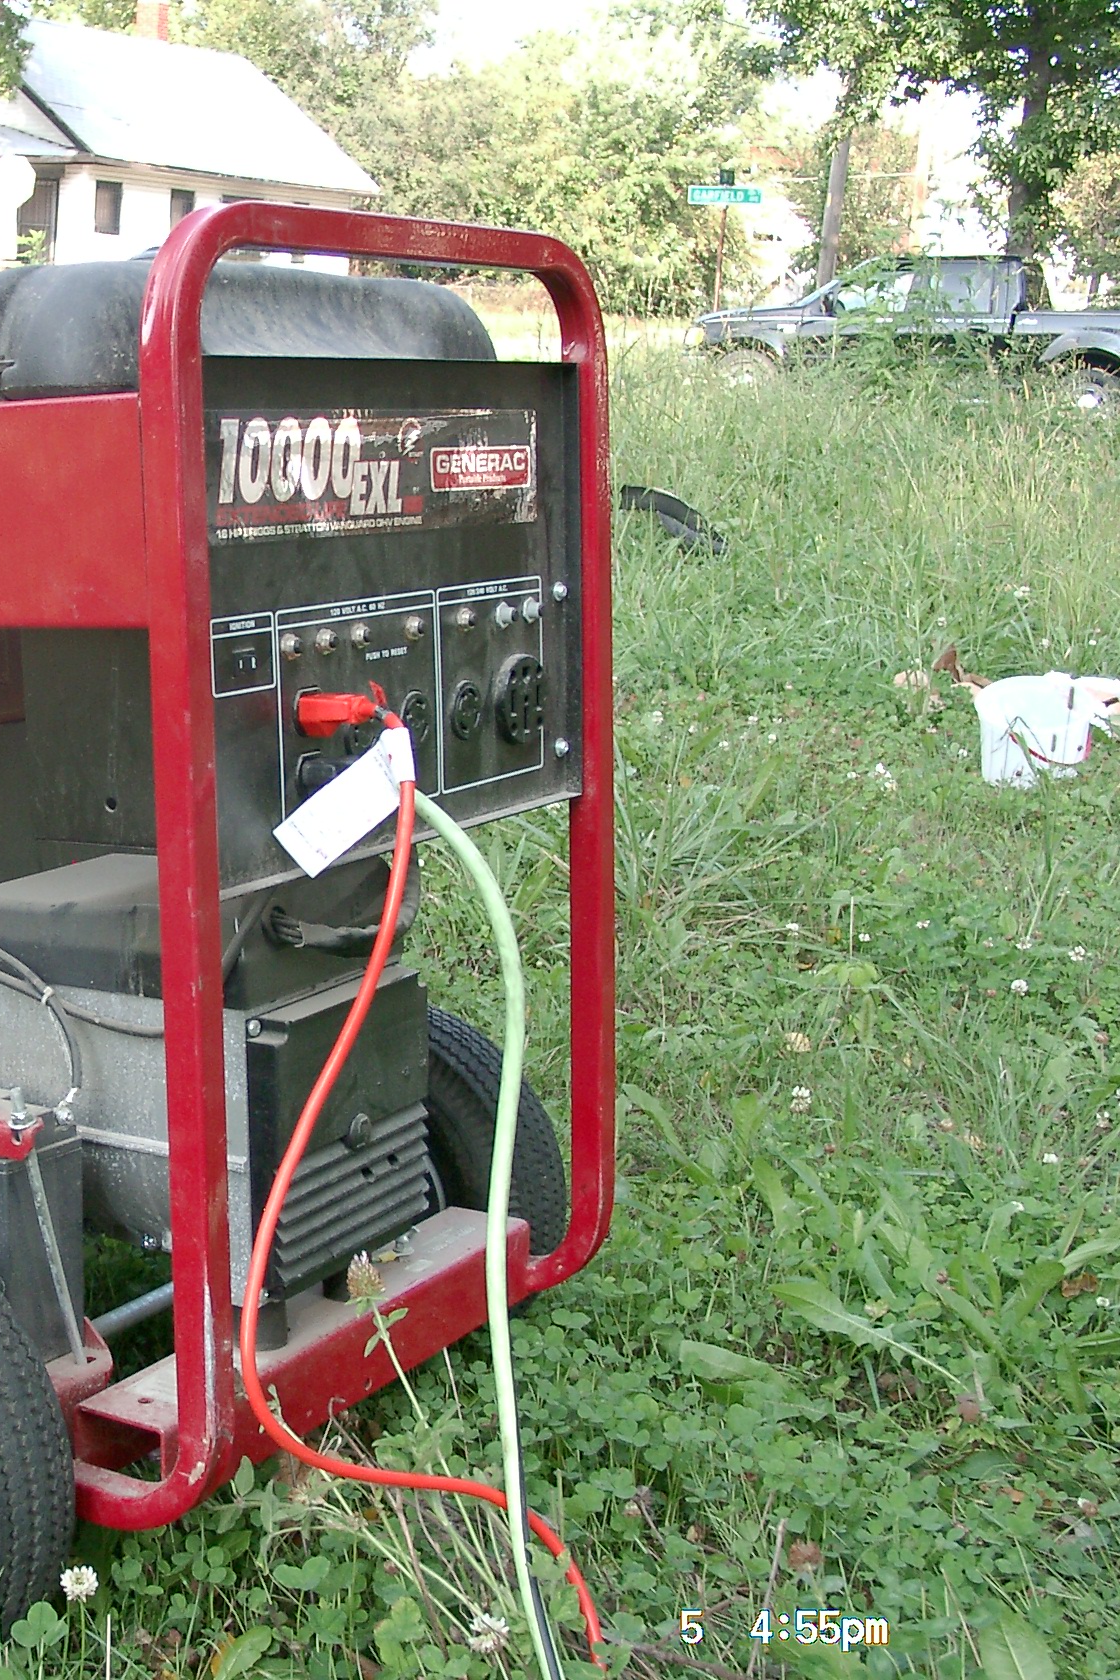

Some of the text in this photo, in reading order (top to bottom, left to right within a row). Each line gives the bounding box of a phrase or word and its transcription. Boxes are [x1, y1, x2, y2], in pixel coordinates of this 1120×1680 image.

[693, 189, 744, 202] GARFIELD
[219, 417, 402, 516] 10000 EXL
[436, 452, 526, 474] GENERAC
[277, 525, 284, 535] &
[284, 522, 330, 535] STRATTON
[330, 519, 376, 530] VANGUARD
[394, 516, 423, 526] ENGINE
[381, 649, 390, 658] TO
